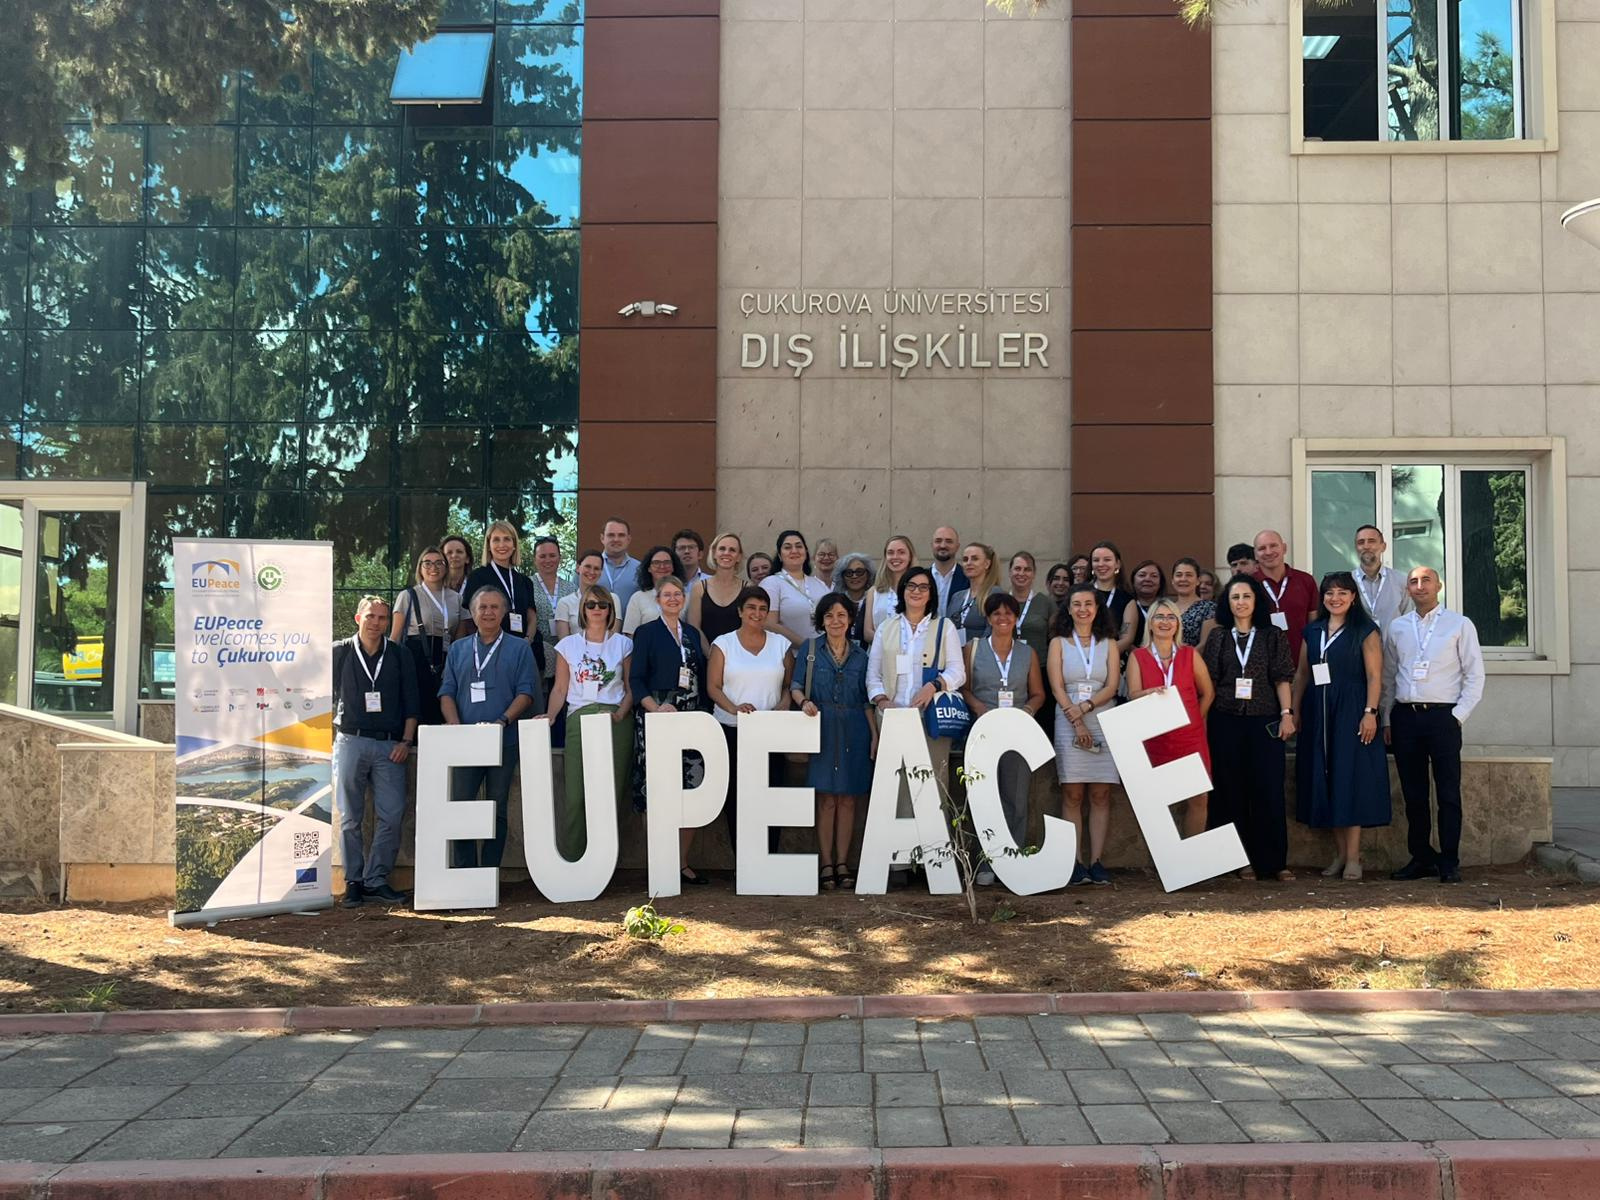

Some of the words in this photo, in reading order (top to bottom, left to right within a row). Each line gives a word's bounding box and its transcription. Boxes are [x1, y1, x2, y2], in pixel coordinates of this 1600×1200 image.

[740, 292, 872, 318] ÇUKUROVA
[882, 287, 1050, 315] ÜNİVERSİTESİ
[741, 332, 814, 378] DIŞ
[839, 323, 1049, 378] İLİŞKİLER
[191, 578, 241, 589] EUPeace
[193, 616, 264, 631] EUPeace
[195, 629, 277, 646] welcomes
[283, 632, 311, 649] you
[191, 649, 208, 664] to
[217, 647, 295, 668] Çukurova
[935, 707, 970, 721] EUPeac
[413, 685, 1251, 911] EUPEACE
